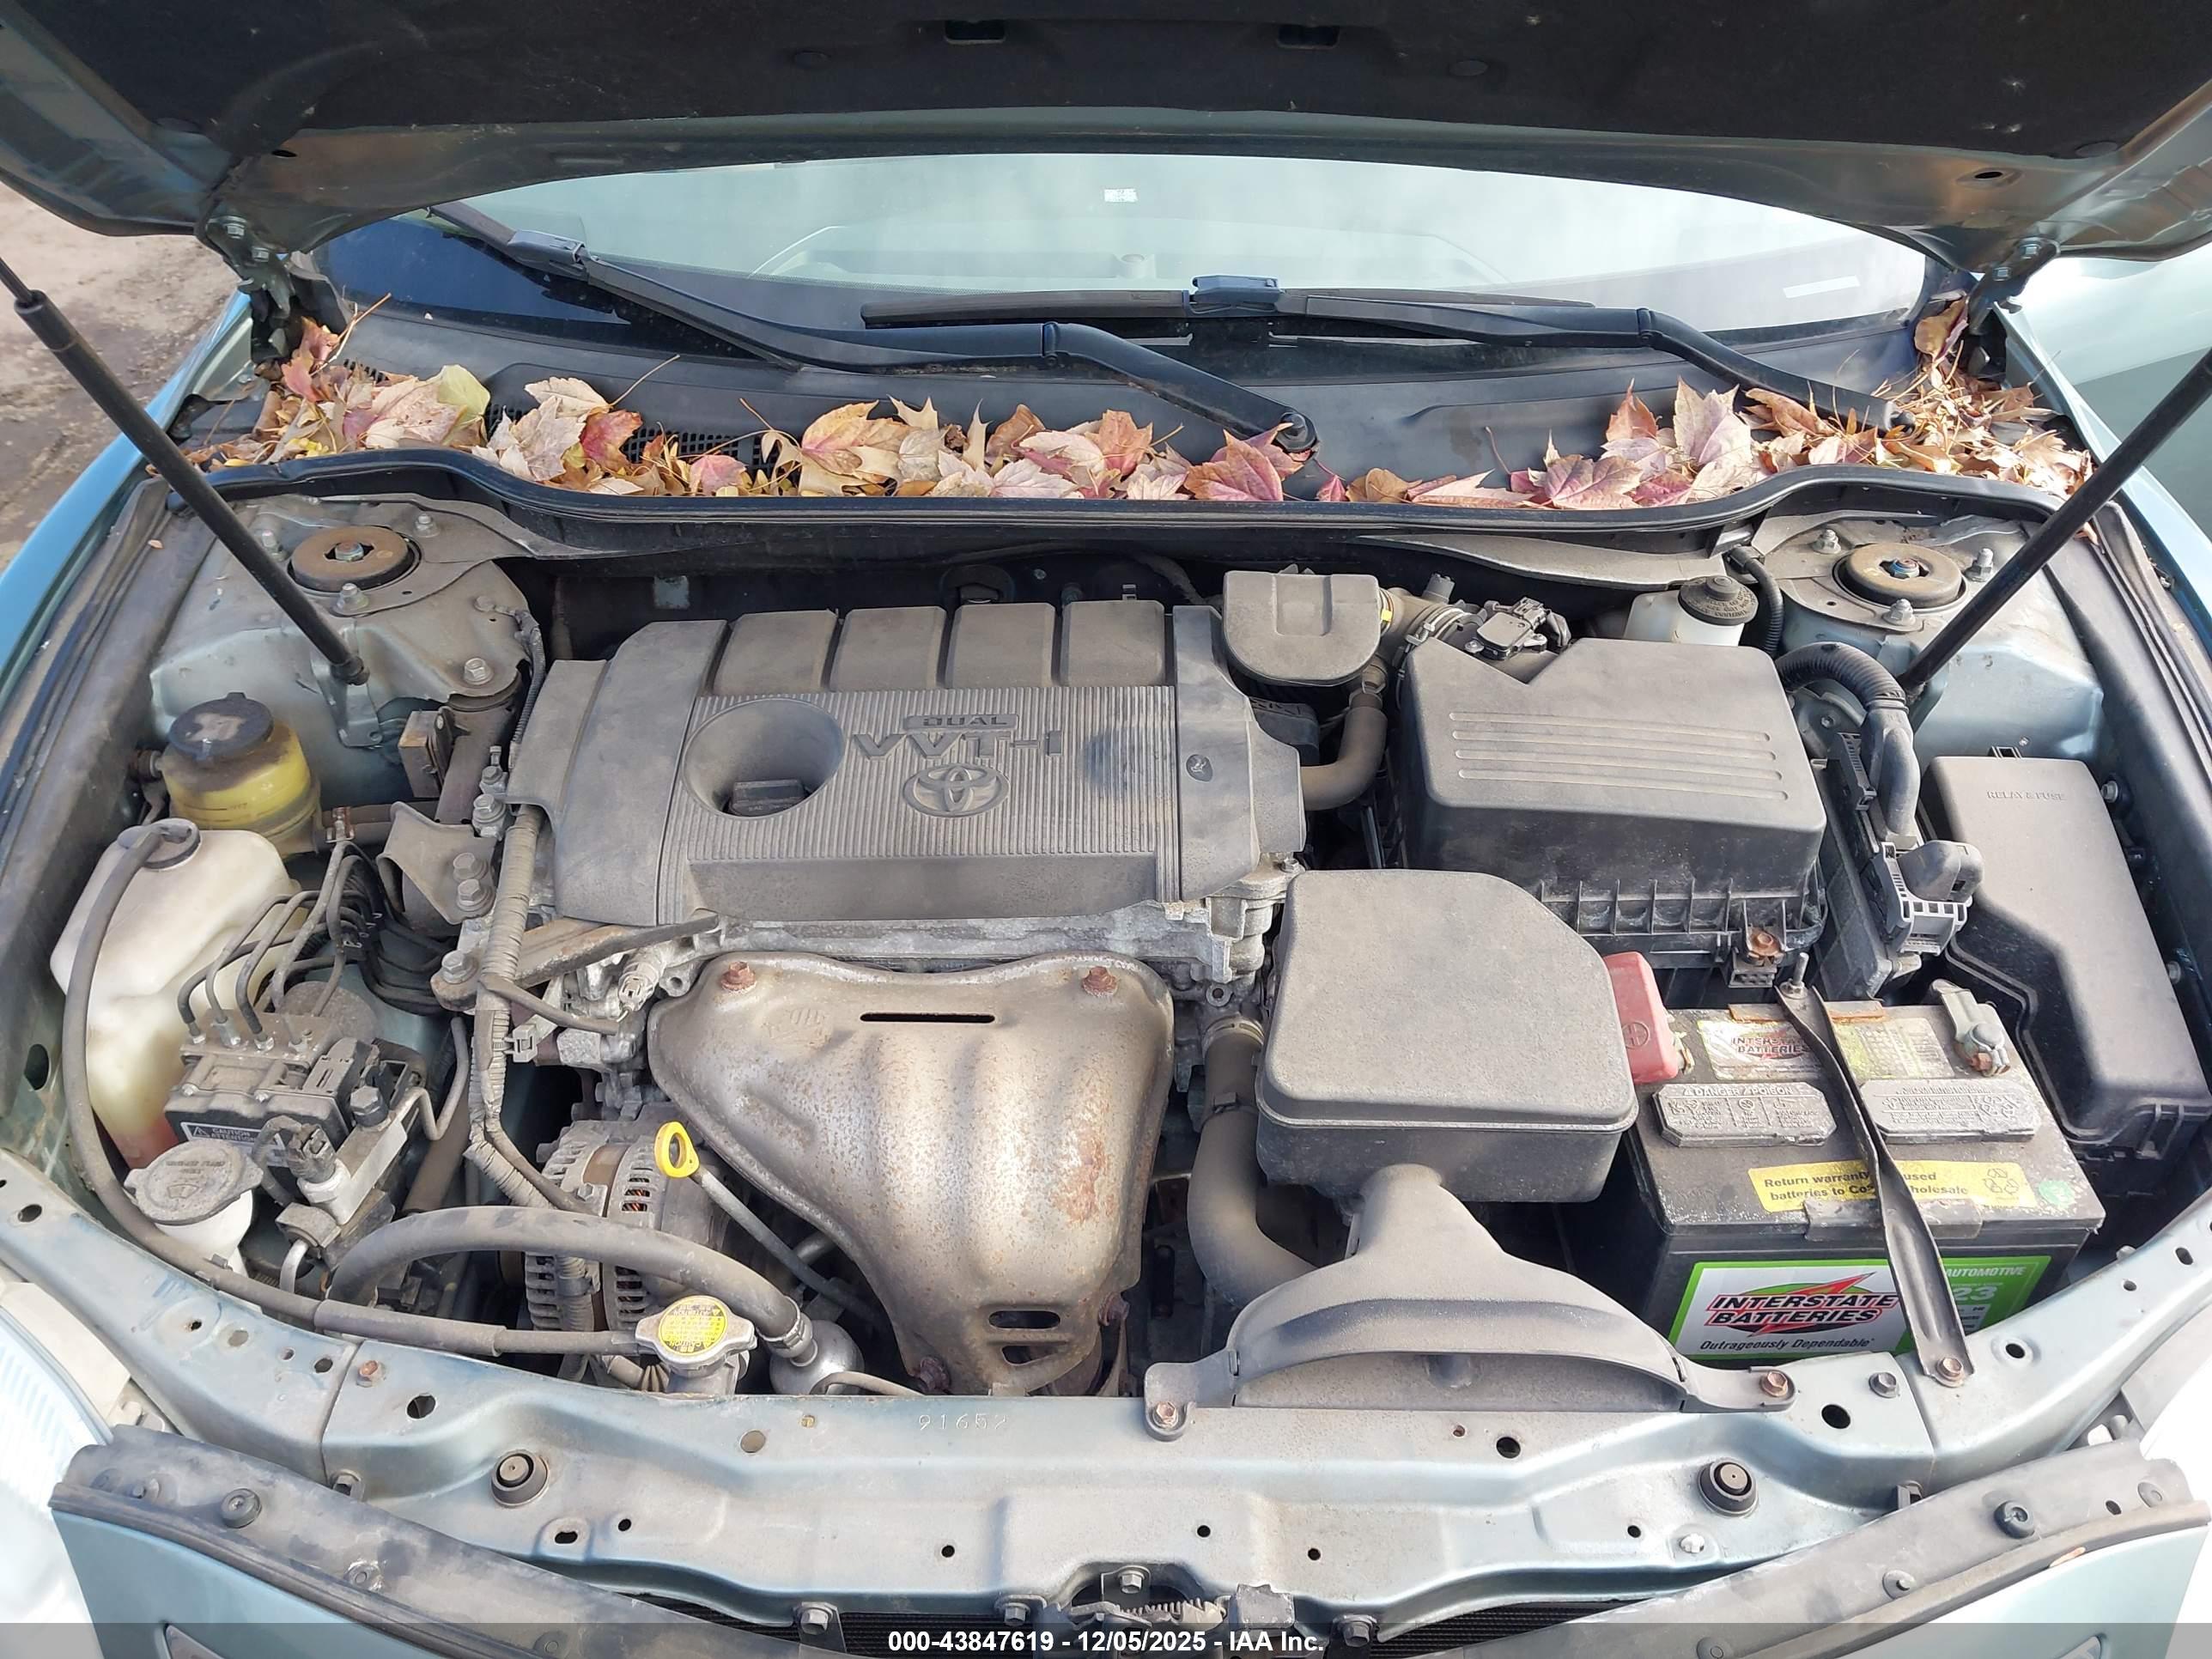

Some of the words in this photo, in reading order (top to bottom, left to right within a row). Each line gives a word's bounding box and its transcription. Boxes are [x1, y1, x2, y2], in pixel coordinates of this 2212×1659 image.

[922, 716, 1008, 726] DUAL
[1986, 791, 2022, 799] RELAY
[2036, 792, 2066, 801] FUSE
[1695, 1087, 1740, 1097] DANGER
[1752, 1086, 1794, 1096] POISON
[212, 1128, 252, 1137] CAUTION
[1765, 1176, 1809, 1188] Return
[1813, 1170, 1870, 1184] warranty
[1904, 1172, 1936, 1181] used
[1771, 1188, 1828, 1201] batteries
[1832, 1187, 1844, 1196] to
[1910, 1185, 1969, 1195] holesale
[1946, 1267, 2027, 1278] AUTOMOTIVE
[1713, 1294, 1899, 1310] INTERSTATE
[1711, 1310, 1881, 1324] BATTERIES
[1699, 1340, 1789, 1352] Outrageously
